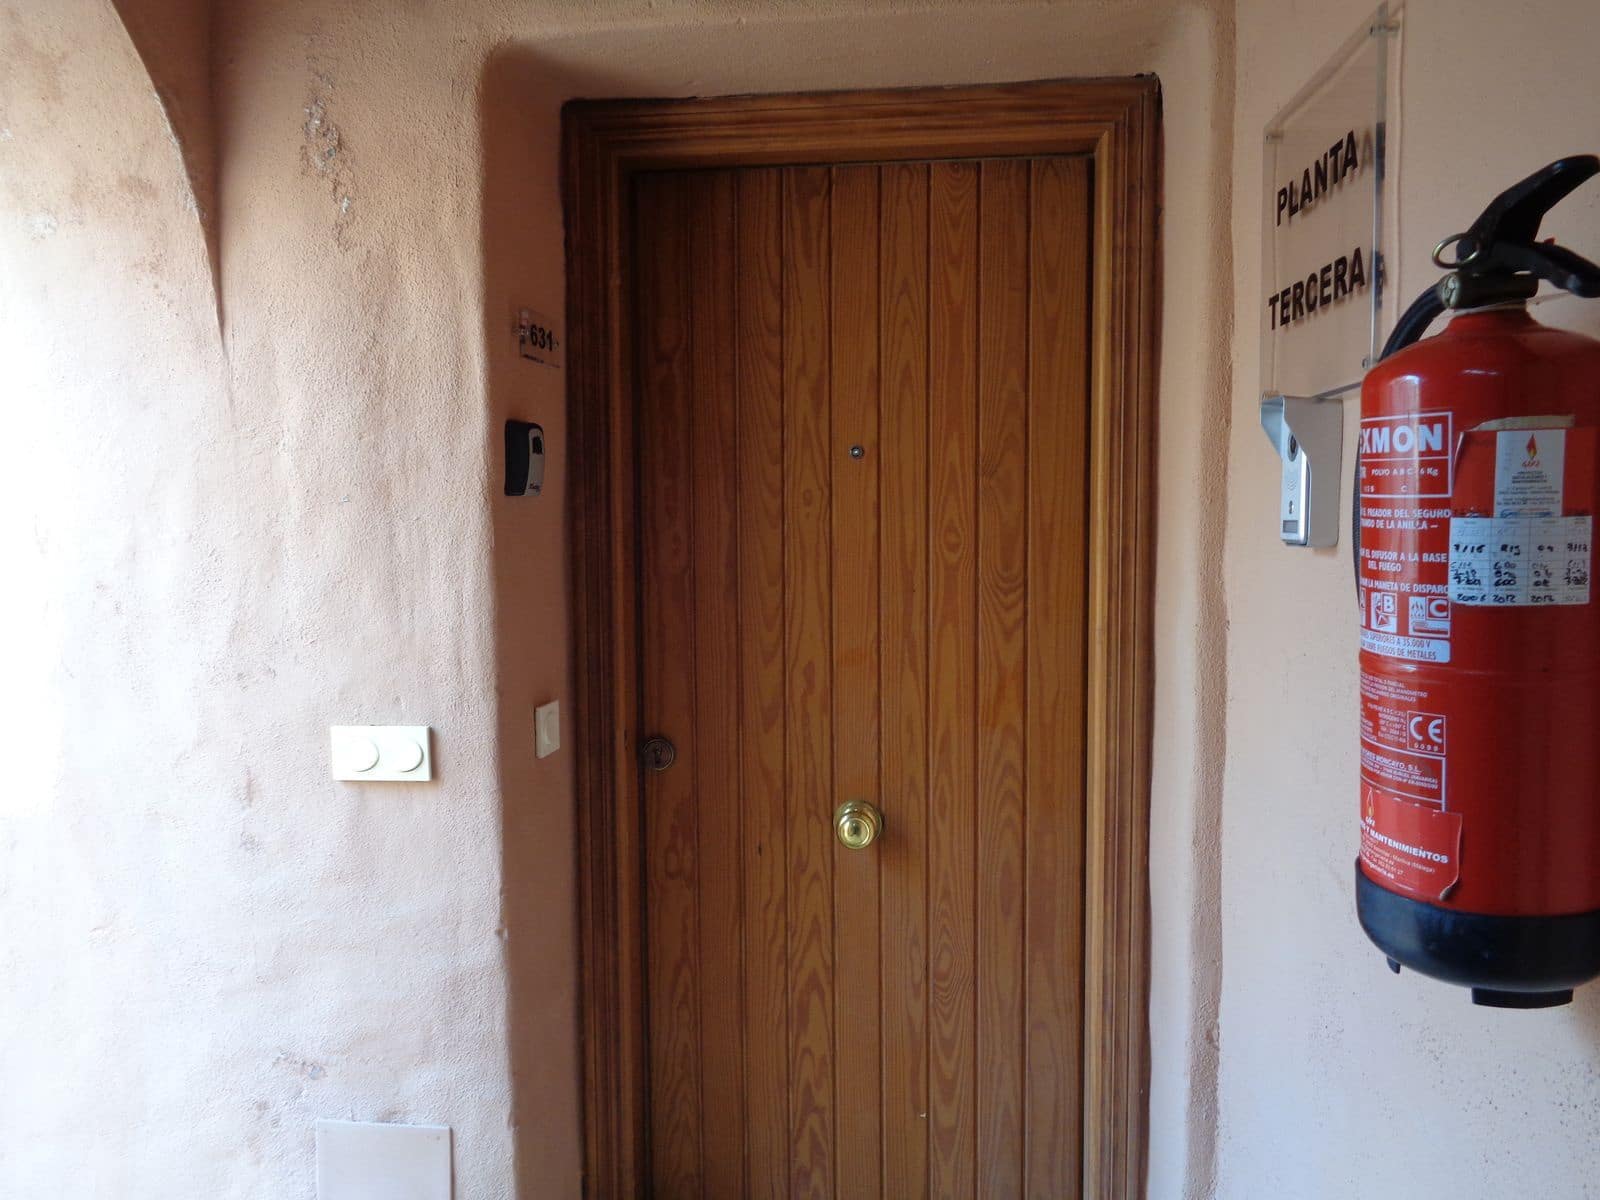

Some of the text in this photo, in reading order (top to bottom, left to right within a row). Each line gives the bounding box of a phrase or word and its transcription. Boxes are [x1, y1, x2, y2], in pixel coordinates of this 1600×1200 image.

[1276, 130, 1359, 227] PLANTA
[1268, 247, 1366, 331] TERCERA
[530, 324, 553, 352] 631
[1360, 423, 1443, 454] XMON
[1394, 508, 1410, 518] DEL
[1412, 508, 1451, 519] SEGURO
[1386, 520, 1395, 529] LA
[1397, 520, 1428, 530] ANILLA
[1400, 552, 1406, 561] A
[1408, 552, 1419, 562] LA
[1422, 553, 1448, 563] BASE
[1379, 561, 1402, 572] FUEGO
[1400, 583, 1411, 593] DE
[1383, 596, 1394, 611] B
[1429, 599, 1449, 618] C
[1407, 648, 1437, 661] METALES
[1369, 828, 1450, 864] MANTENIMIENTOS
